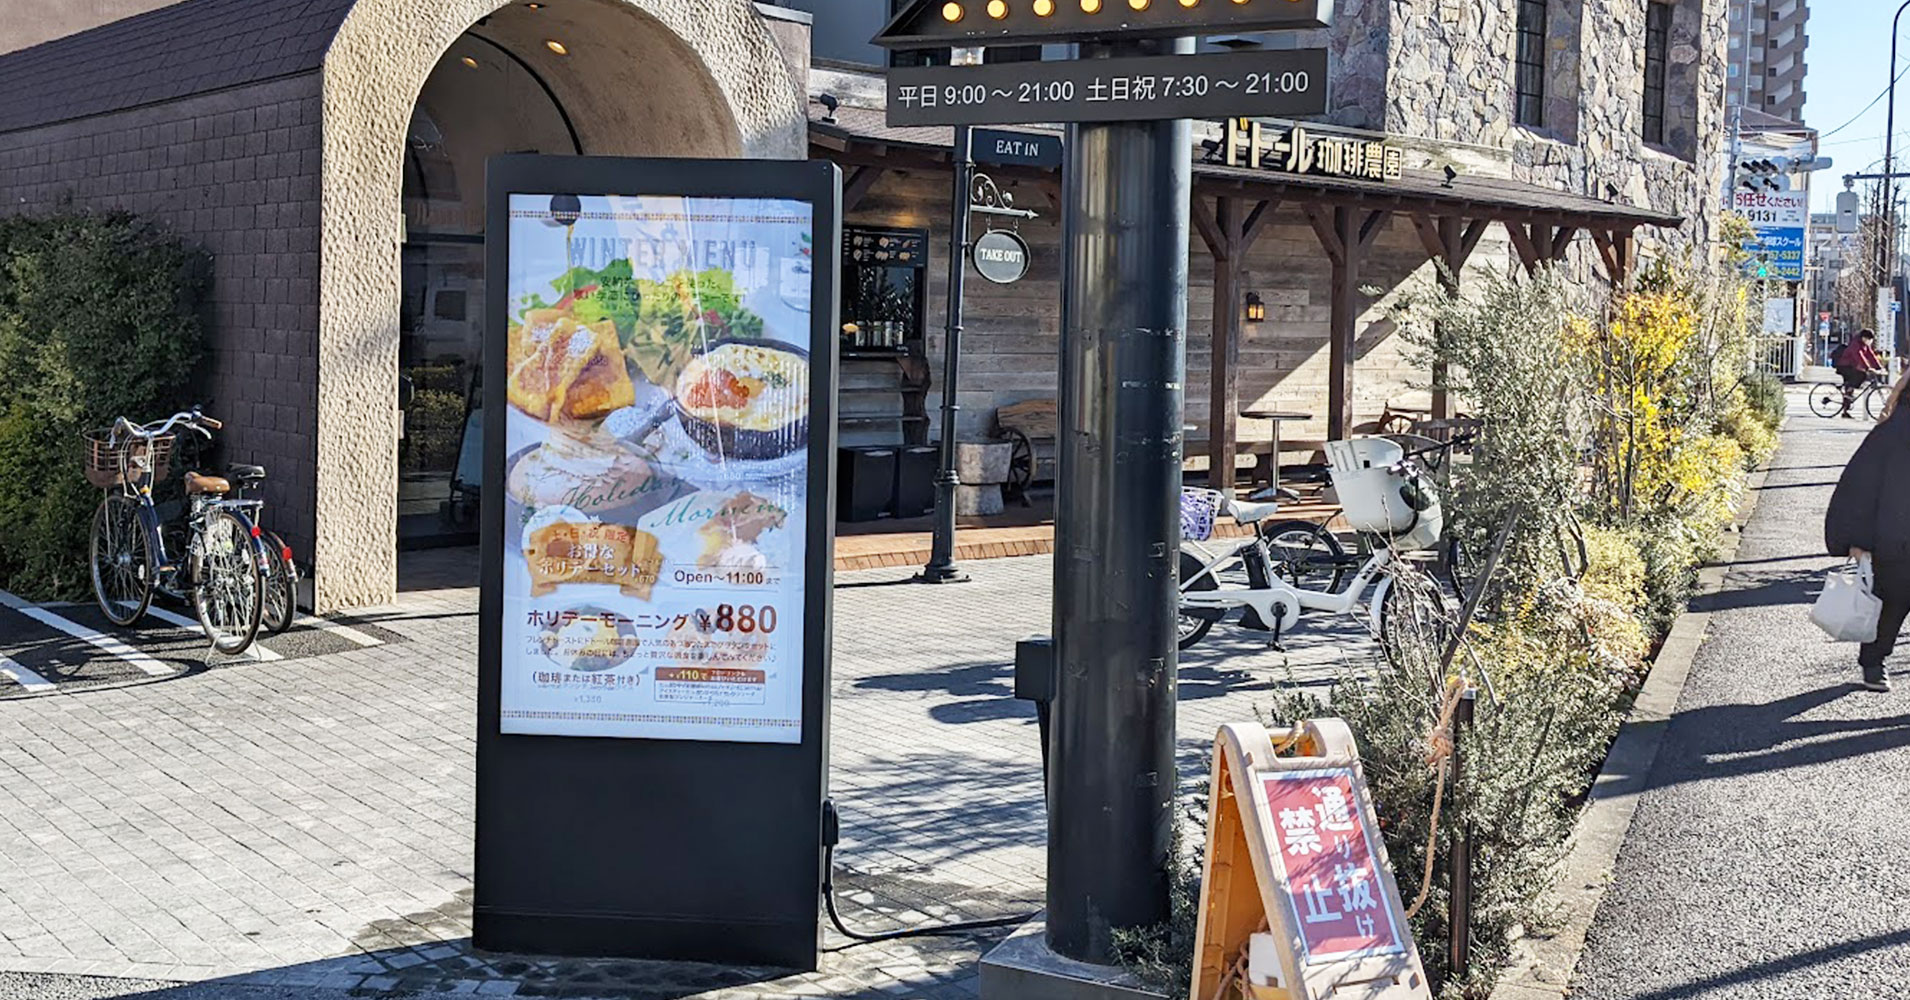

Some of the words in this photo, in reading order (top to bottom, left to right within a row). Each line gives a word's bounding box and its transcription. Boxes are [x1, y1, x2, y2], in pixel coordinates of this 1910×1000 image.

[898, 85, 938, 109] 平日
[944, 84, 986, 105] 9:00
[1018, 81, 1075, 102] 21:00
[1086, 76, 1156, 102] 土日祝
[1162, 75, 1209, 97] 7:30
[1245, 71, 1309, 94] 21:00
[995, 140, 1022, 156] EAT
[1024, 142, 1039, 156] IN
[1226, 117, 1401, 180] ドトール珈琲農園
[571, 237, 666, 269] WINTER
[680, 239, 756, 270] MENU
[981, 248, 1003, 261] TAKE
[1003, 250, 1023, 263] OUT
[560, 476, 688, 514] Holiday
[567, 543, 615, 559] お得な
[539, 558, 642, 578] ホリデーセット
[527, 609, 689, 631] ホリデーモーニング
[699, 603, 777, 634] ¥880
[1278, 806, 1343, 924] 禁止
[1311, 785, 1377, 939] 通り抜け
